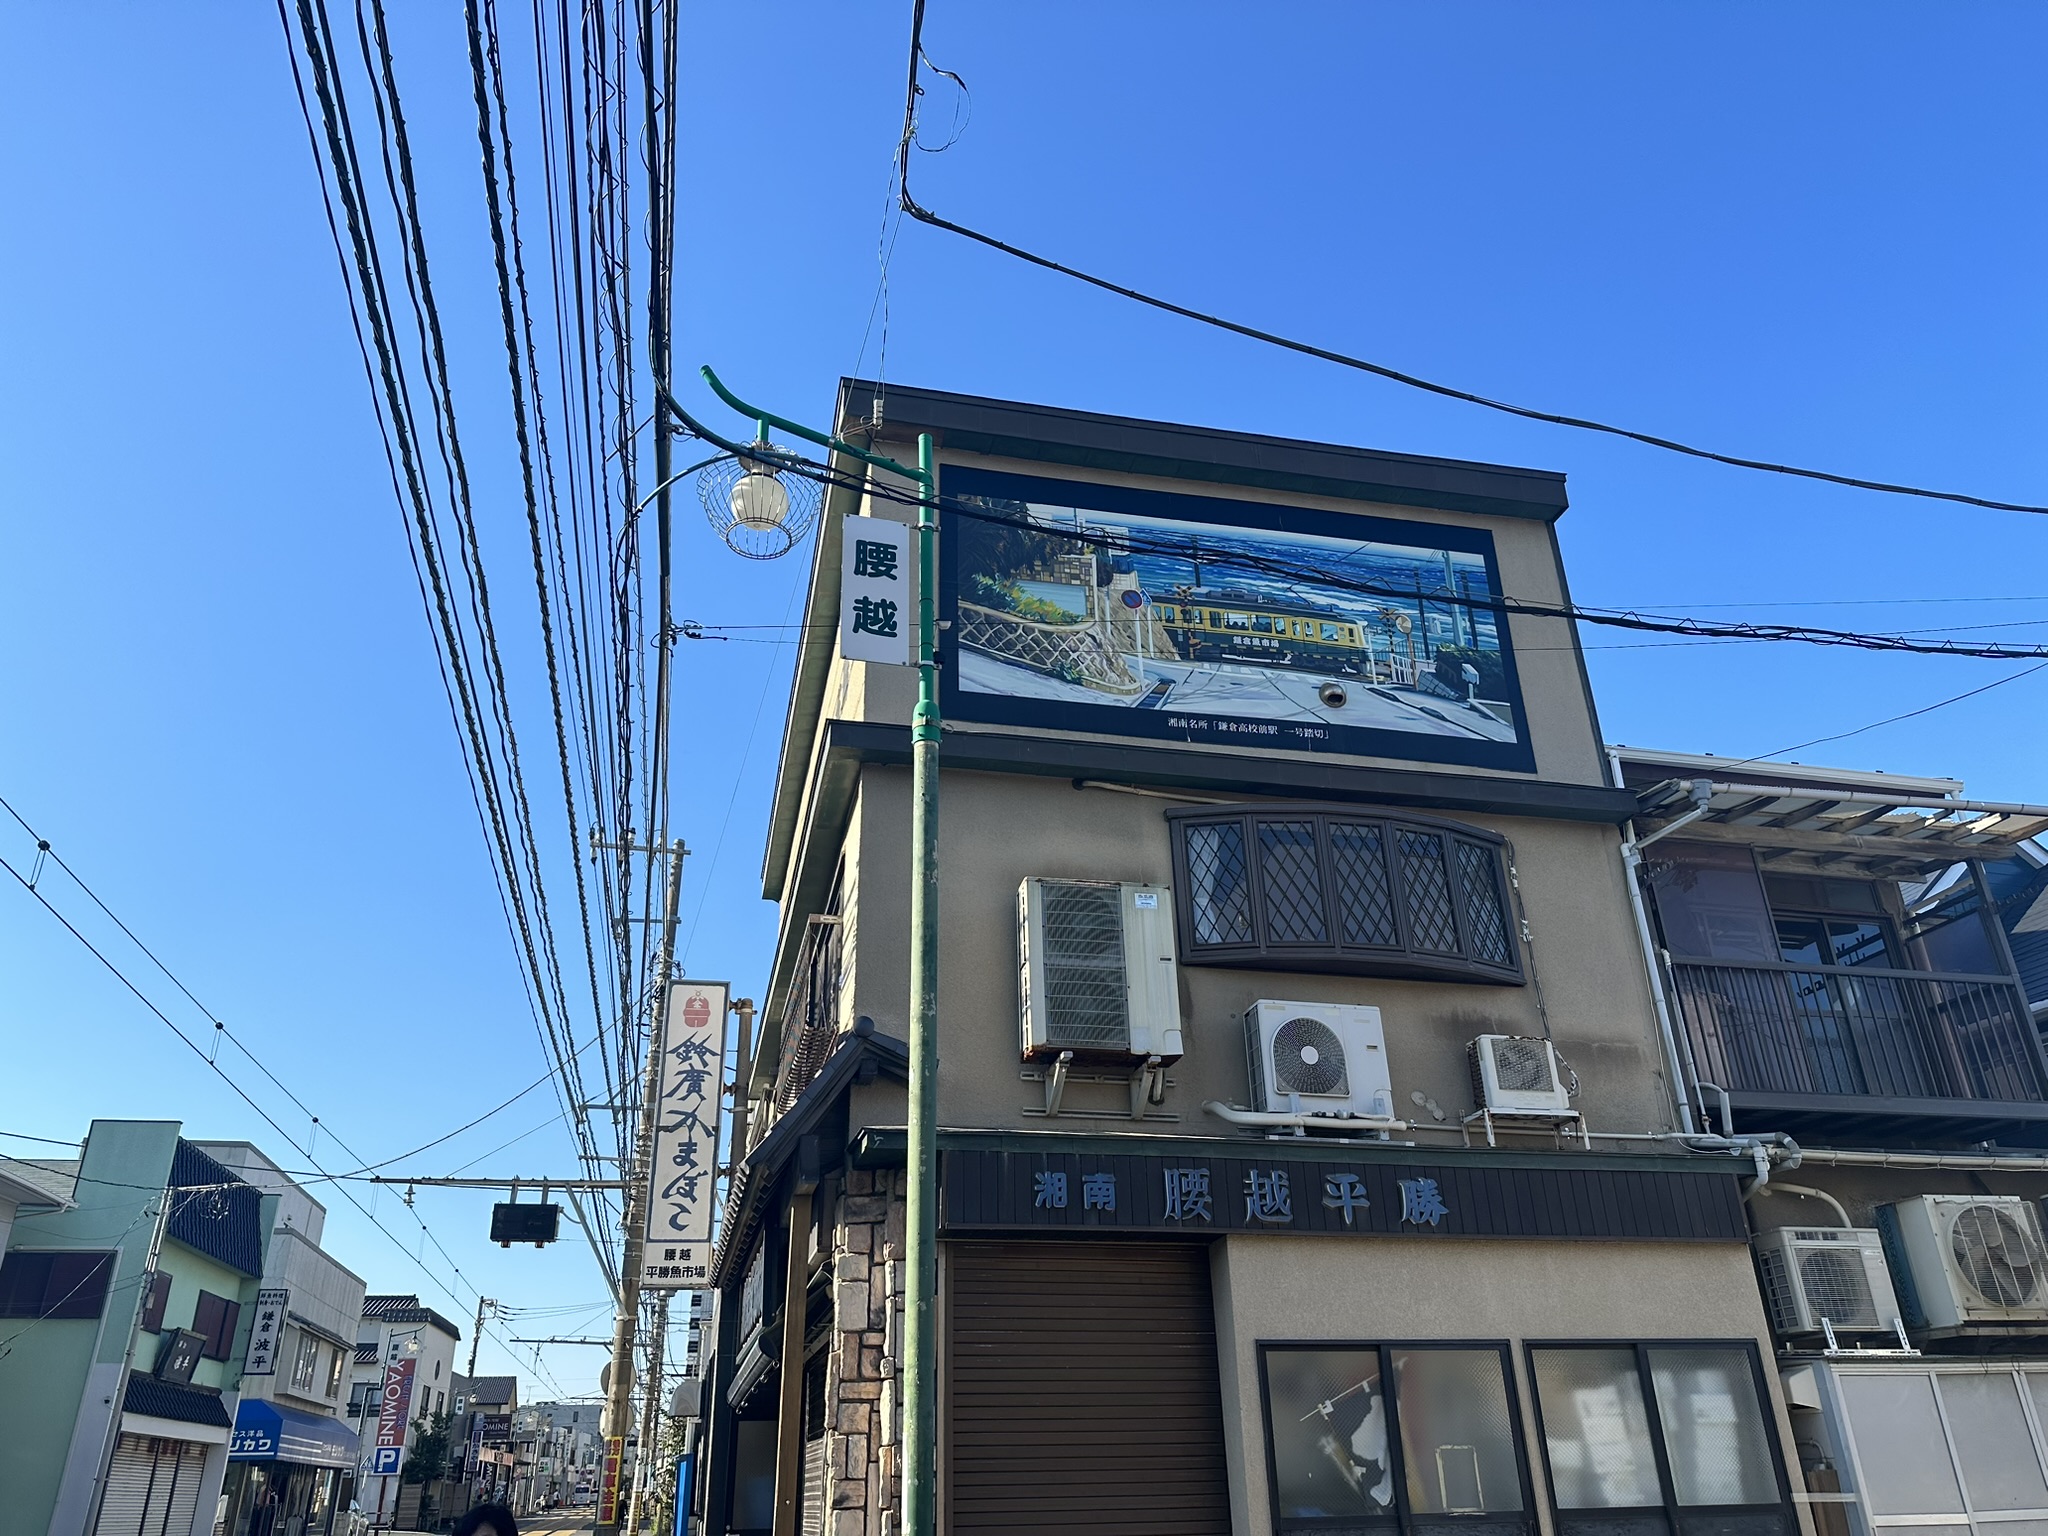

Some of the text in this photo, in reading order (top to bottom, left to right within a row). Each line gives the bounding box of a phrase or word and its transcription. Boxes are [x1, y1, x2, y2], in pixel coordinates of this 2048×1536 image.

[853, 539, 898, 638] 腰越
[661, 1031, 720, 1232] 鈴廣かまぼこ
[1034, 1167, 1449, 1227] 湘南 腰越平勝
[646, 1265, 706, 1279] 平勝魚市場
[664, 1248, 691, 1261] 腰越
[252, 1311, 275, 1368] 鎌倉 波平
[378, 1361, 405, 1445] YAOMINE
[377, 1450, 396, 1472] P
